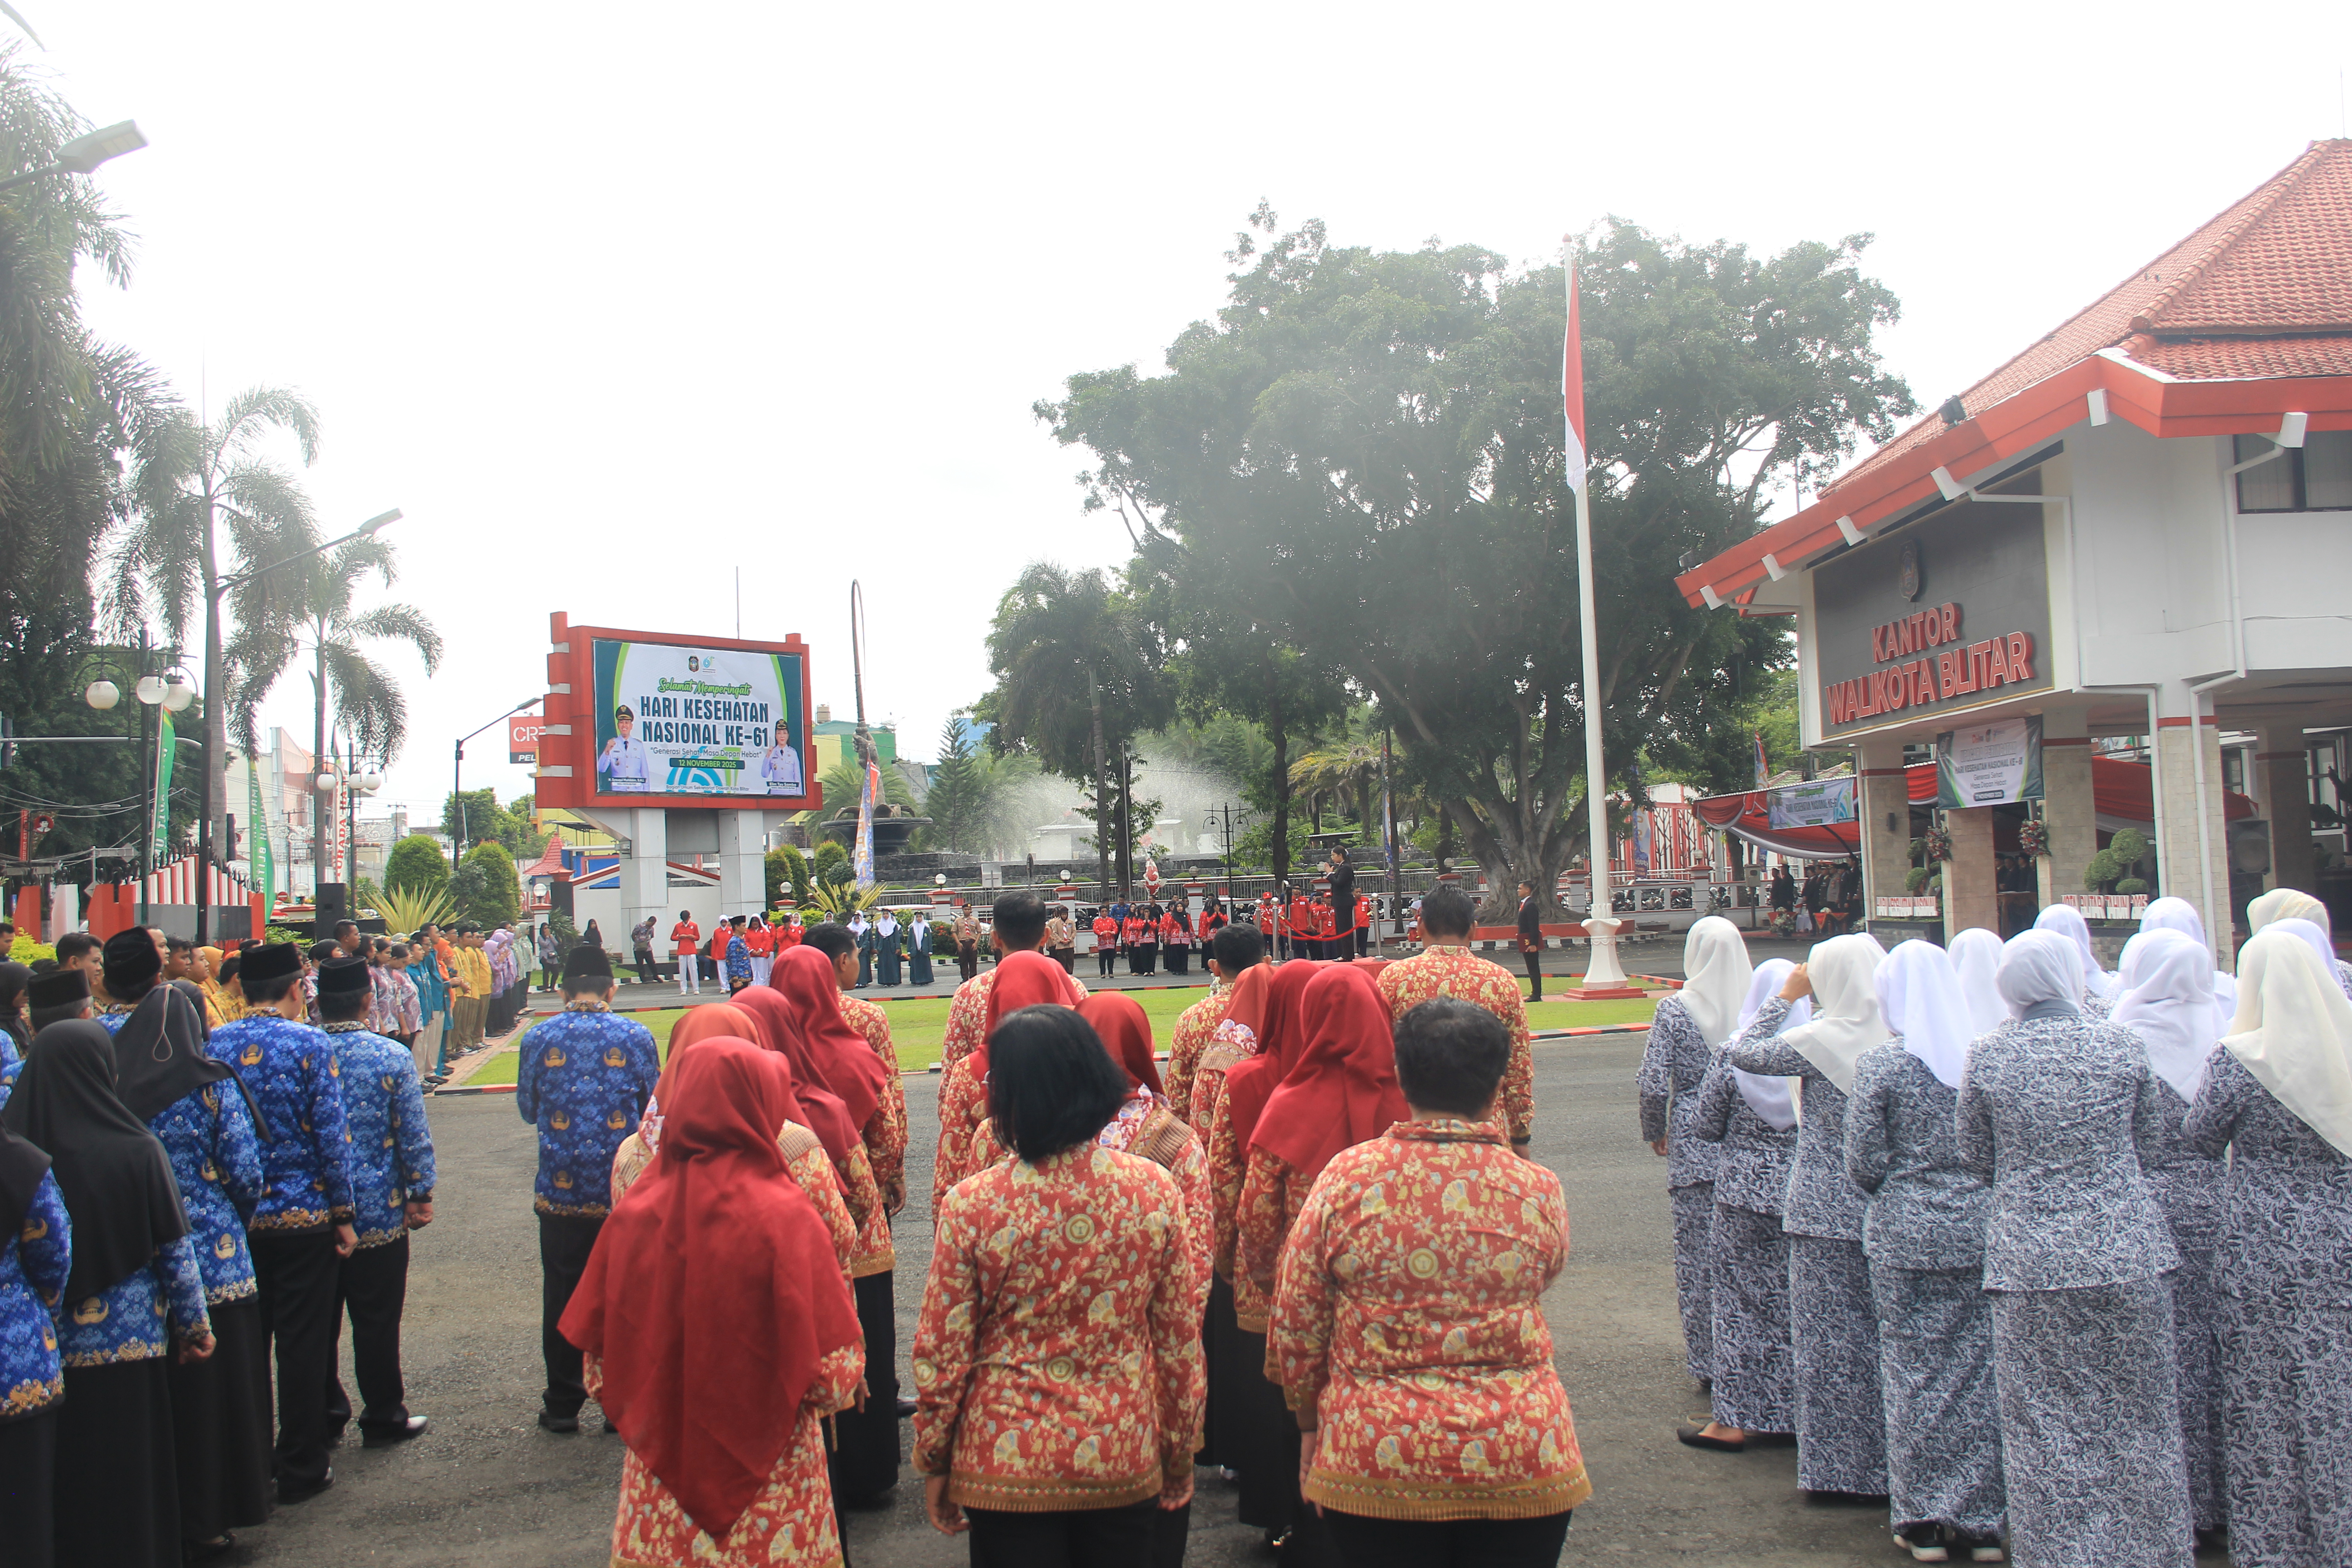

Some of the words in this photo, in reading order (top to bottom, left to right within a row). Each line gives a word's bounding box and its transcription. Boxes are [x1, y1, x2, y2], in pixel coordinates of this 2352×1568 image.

[1871, 602, 1960, 663] KANTOR
[658, 677, 696, 692] Selamat
[694, 681, 752, 699] Memperingati
[1825, 658, 1939, 725] WALIKOTA
[1938, 631, 2034, 699] BLITAR
[641, 696, 677, 717] HARI
[684, 699, 768, 722] KESEHATAN
[642, 721, 720, 745] NASIONAL
[726, 725, 768, 747] KE-61
[1988, 759, 2009, 770] NASIONAL
[1981, 780, 1994, 789] Depan
